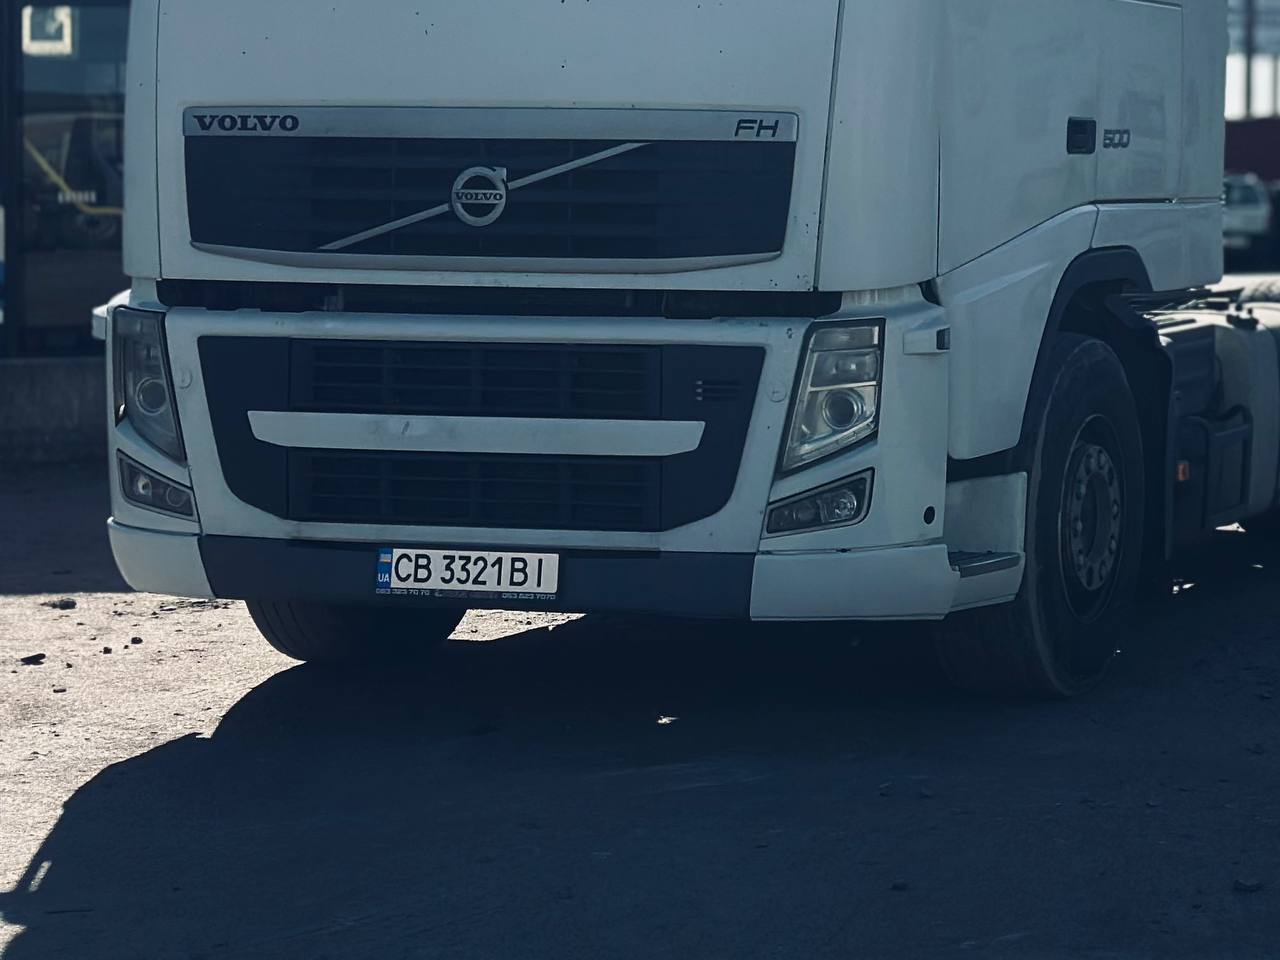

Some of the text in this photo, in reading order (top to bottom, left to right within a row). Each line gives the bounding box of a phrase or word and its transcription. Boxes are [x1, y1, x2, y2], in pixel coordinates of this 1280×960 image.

[192, 115, 300, 132] VOLVO
[735, 119, 779, 138] FH
[454, 191, 504, 201] VOLVO
[378, 573, 390, 583] UA
[394, 553, 432, 584] CB
[440, 555, 503, 587] 3321
